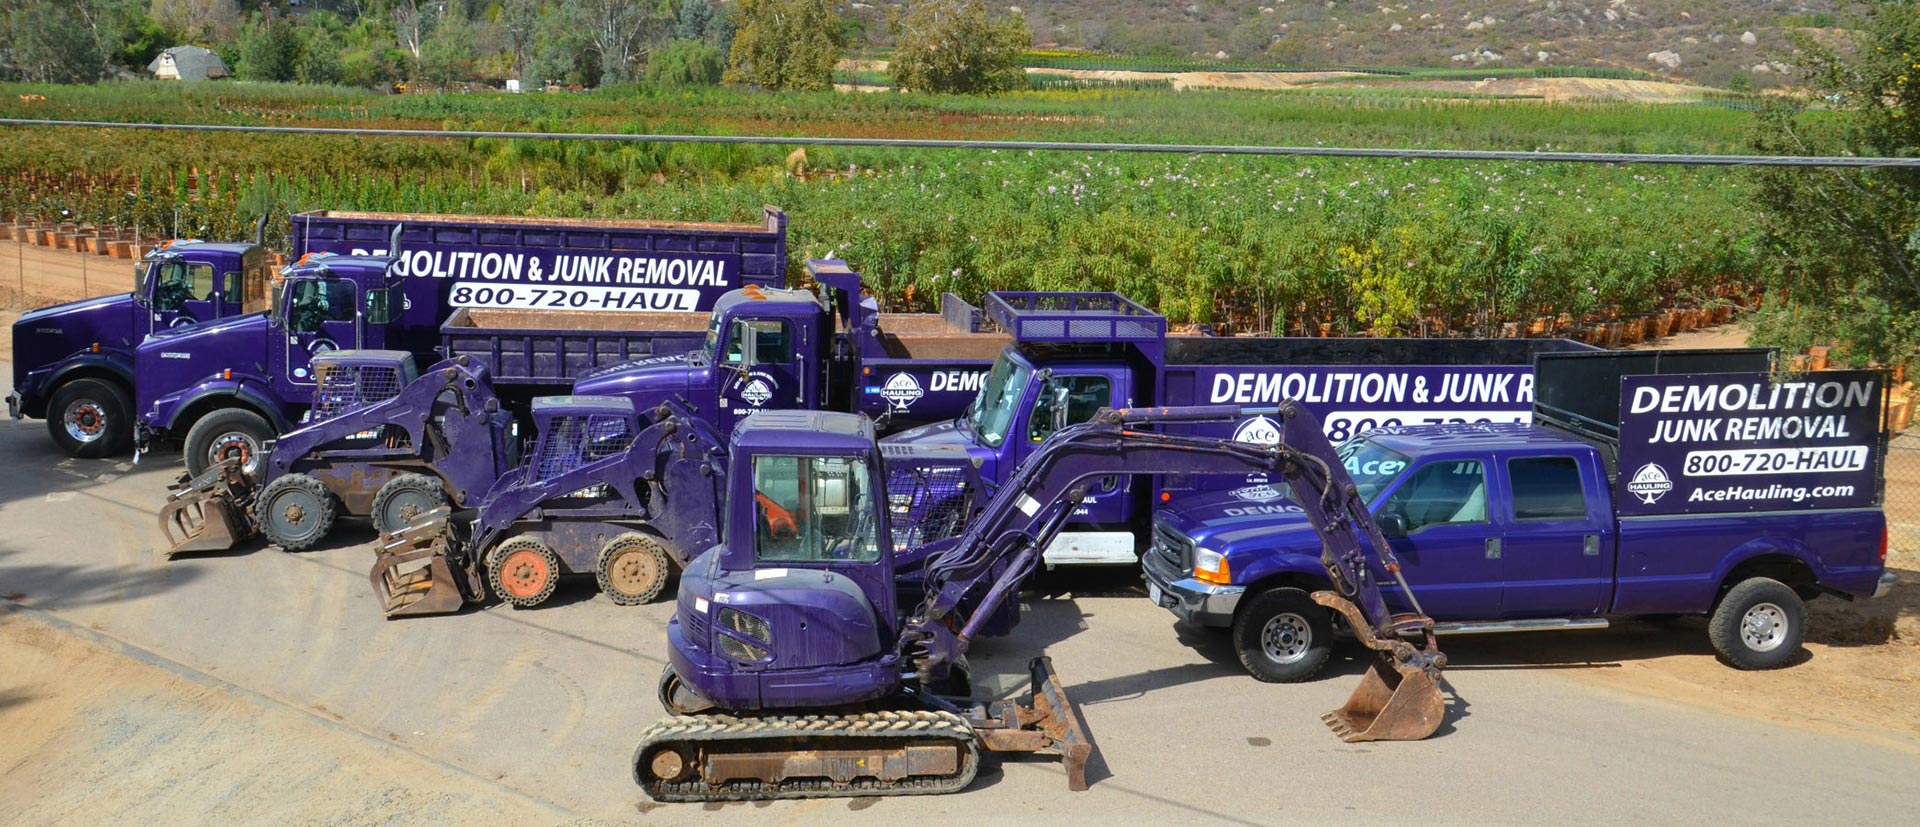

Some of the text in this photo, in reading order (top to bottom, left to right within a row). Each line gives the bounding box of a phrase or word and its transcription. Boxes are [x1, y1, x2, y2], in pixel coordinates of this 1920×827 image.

[351, 248, 728, 286] MOLITION & JUNK REMOVAL
[453, 287, 689, 310] 800-720-HAUL
[1210, 373, 1408, 403] DEMOLITION
[1413, 375, 1428, 403] &
[1434, 373, 1514, 403] JUNK
[1630, 381, 1874, 414] DEMOLITION
[1245, 428, 1275, 442] ace
[1649, 415, 1850, 444] JUNK REMOVAL
[1687, 450, 1859, 473] 800-720-HAUL
[1630, 482, 1670, 490] HAULING
[1641, 471, 1660, 482] ace
[1688, 484, 1854, 502] AceHauling.com
